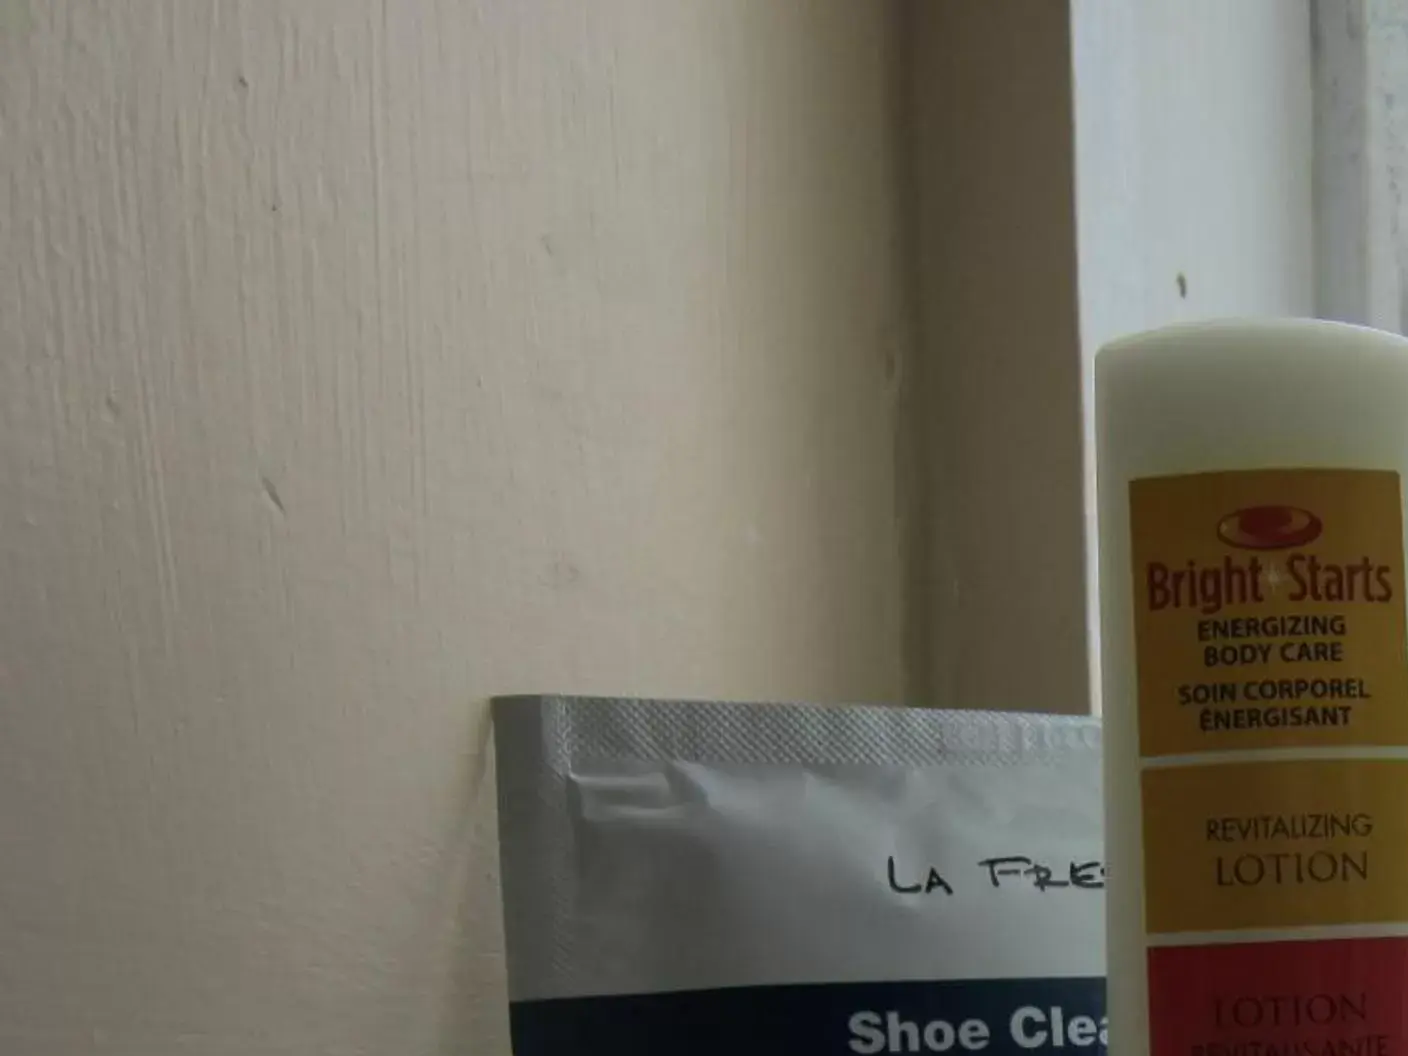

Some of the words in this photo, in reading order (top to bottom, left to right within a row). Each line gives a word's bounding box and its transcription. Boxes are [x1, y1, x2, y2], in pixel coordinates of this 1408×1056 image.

[1147, 556, 1264, 614] Bright
[1287, 554, 1393, 602] Starts
[1197, 615, 1346, 641] ENERGIZING
[1204, 643, 1272, 667] BODY
[1280, 642, 1343, 663] CARE
[1178, 683, 1236, 705] SOIN
[1243, 678, 1371, 700] CORPOREL
[1199, 705, 1351, 731] ÉNERGISANT
[1206, 813, 1373, 842] REVITALIZING
[887, 855, 953, 895] LA
[977, 856, 1105, 891] FRE
[1216, 851, 1369, 887] LOTION
[1210, 992, 1367, 1029] LOTION
[848, 1009, 990, 1054] Shoe
